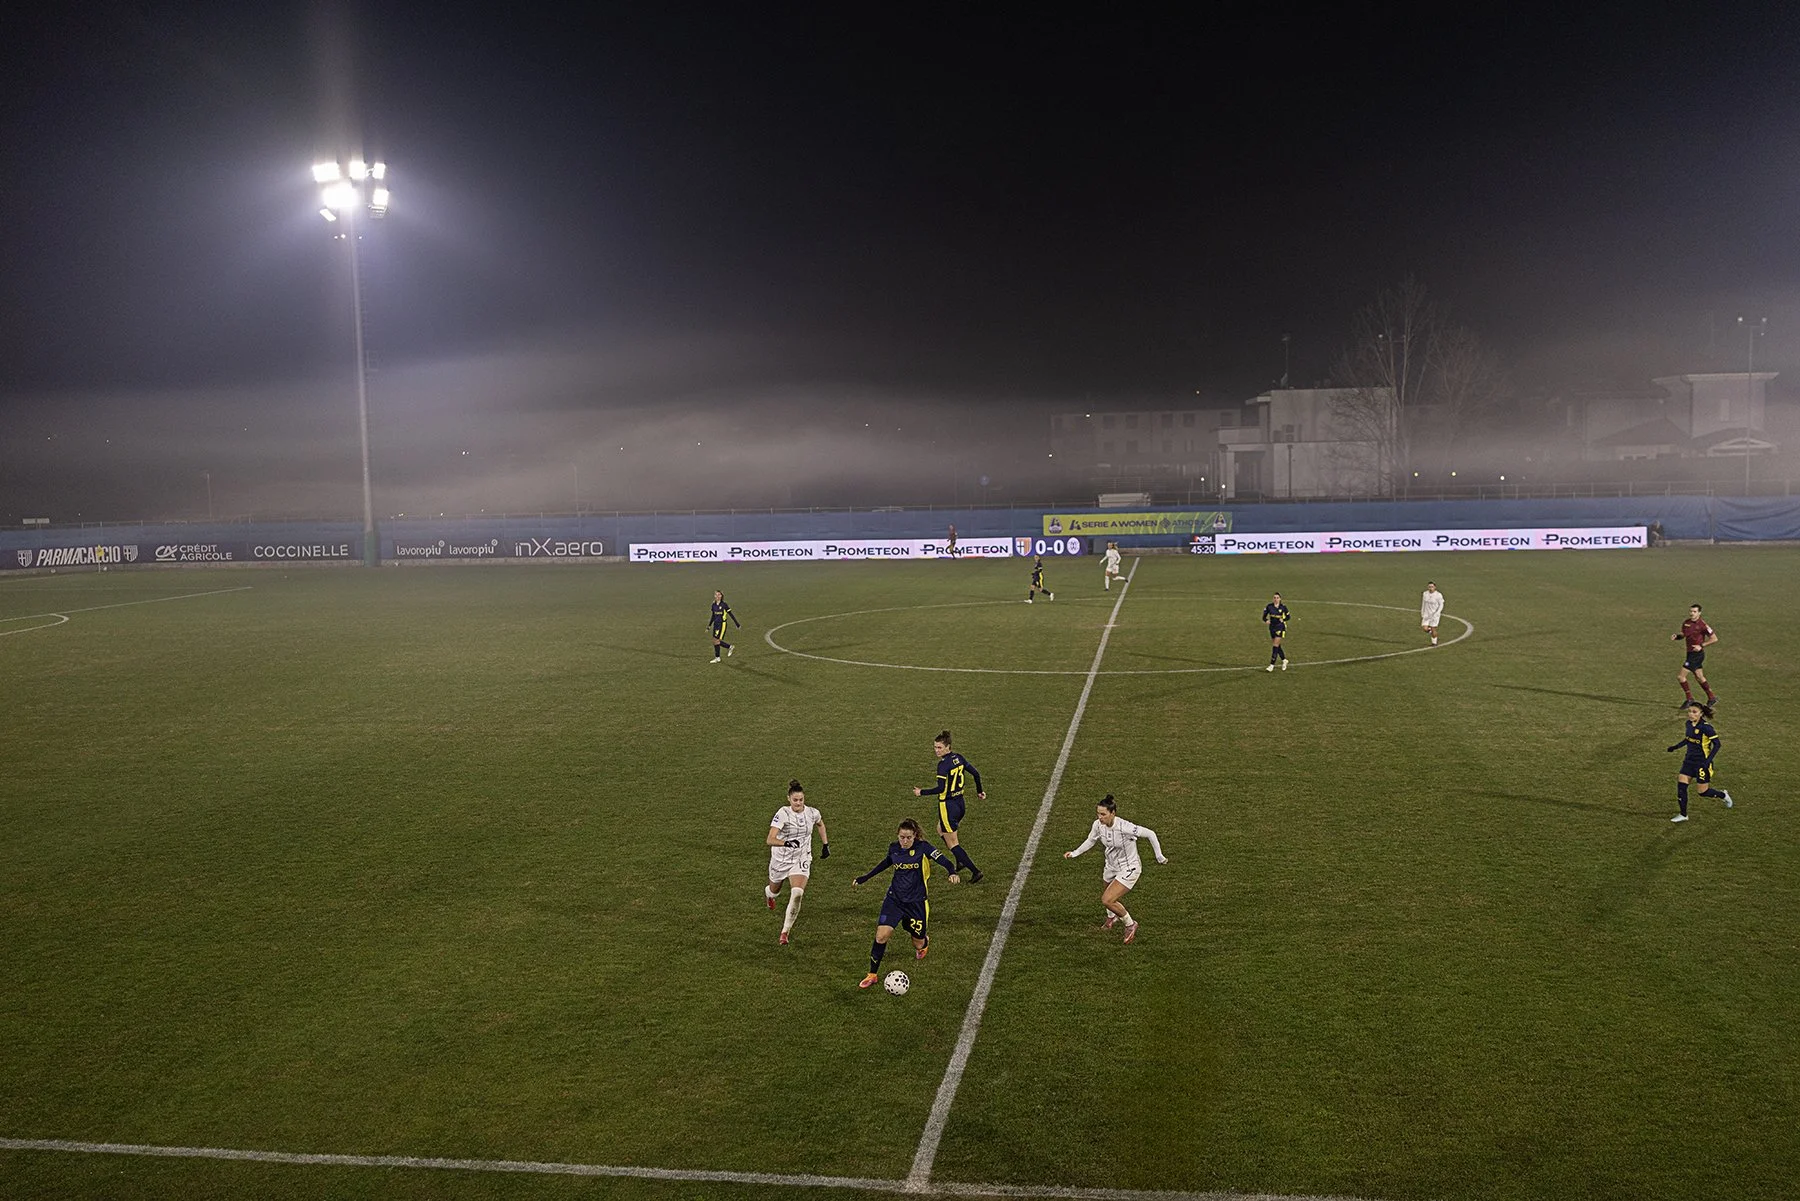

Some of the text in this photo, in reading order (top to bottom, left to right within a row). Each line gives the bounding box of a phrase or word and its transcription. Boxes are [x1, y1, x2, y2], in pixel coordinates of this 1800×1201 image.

[1082, 521, 1109, 529] SERIE
[1119, 520, 1158, 528] WOMEN
[1220, 538, 1315, 550] PROMETEON
[1325, 537, 1422, 549] PROMETEON
[1432, 535, 1530, 547] PROMETEON
[1541, 534, 1642, 546] PROMETEON
[179, 543, 217, 553] CRÉDIT
[254, 544, 349, 558] COCCINELLE
[727, 547, 813, 558] PROMETEON
[822, 545, 910, 556] PROMETEON
[1035, 540, 1065, 555] 0-0
[1190, 545, 1215, 554] 45:20
[180, 552, 233, 561] AGRICOLE
[633, 548, 718, 559] PROMETEON
[1699, 767, 1706, 777] 6
[950, 764, 965, 792] 73
[799, 860, 809, 870] 16
[1126, 867, 1136, 878] 7
[910, 918, 923, 931] 25
